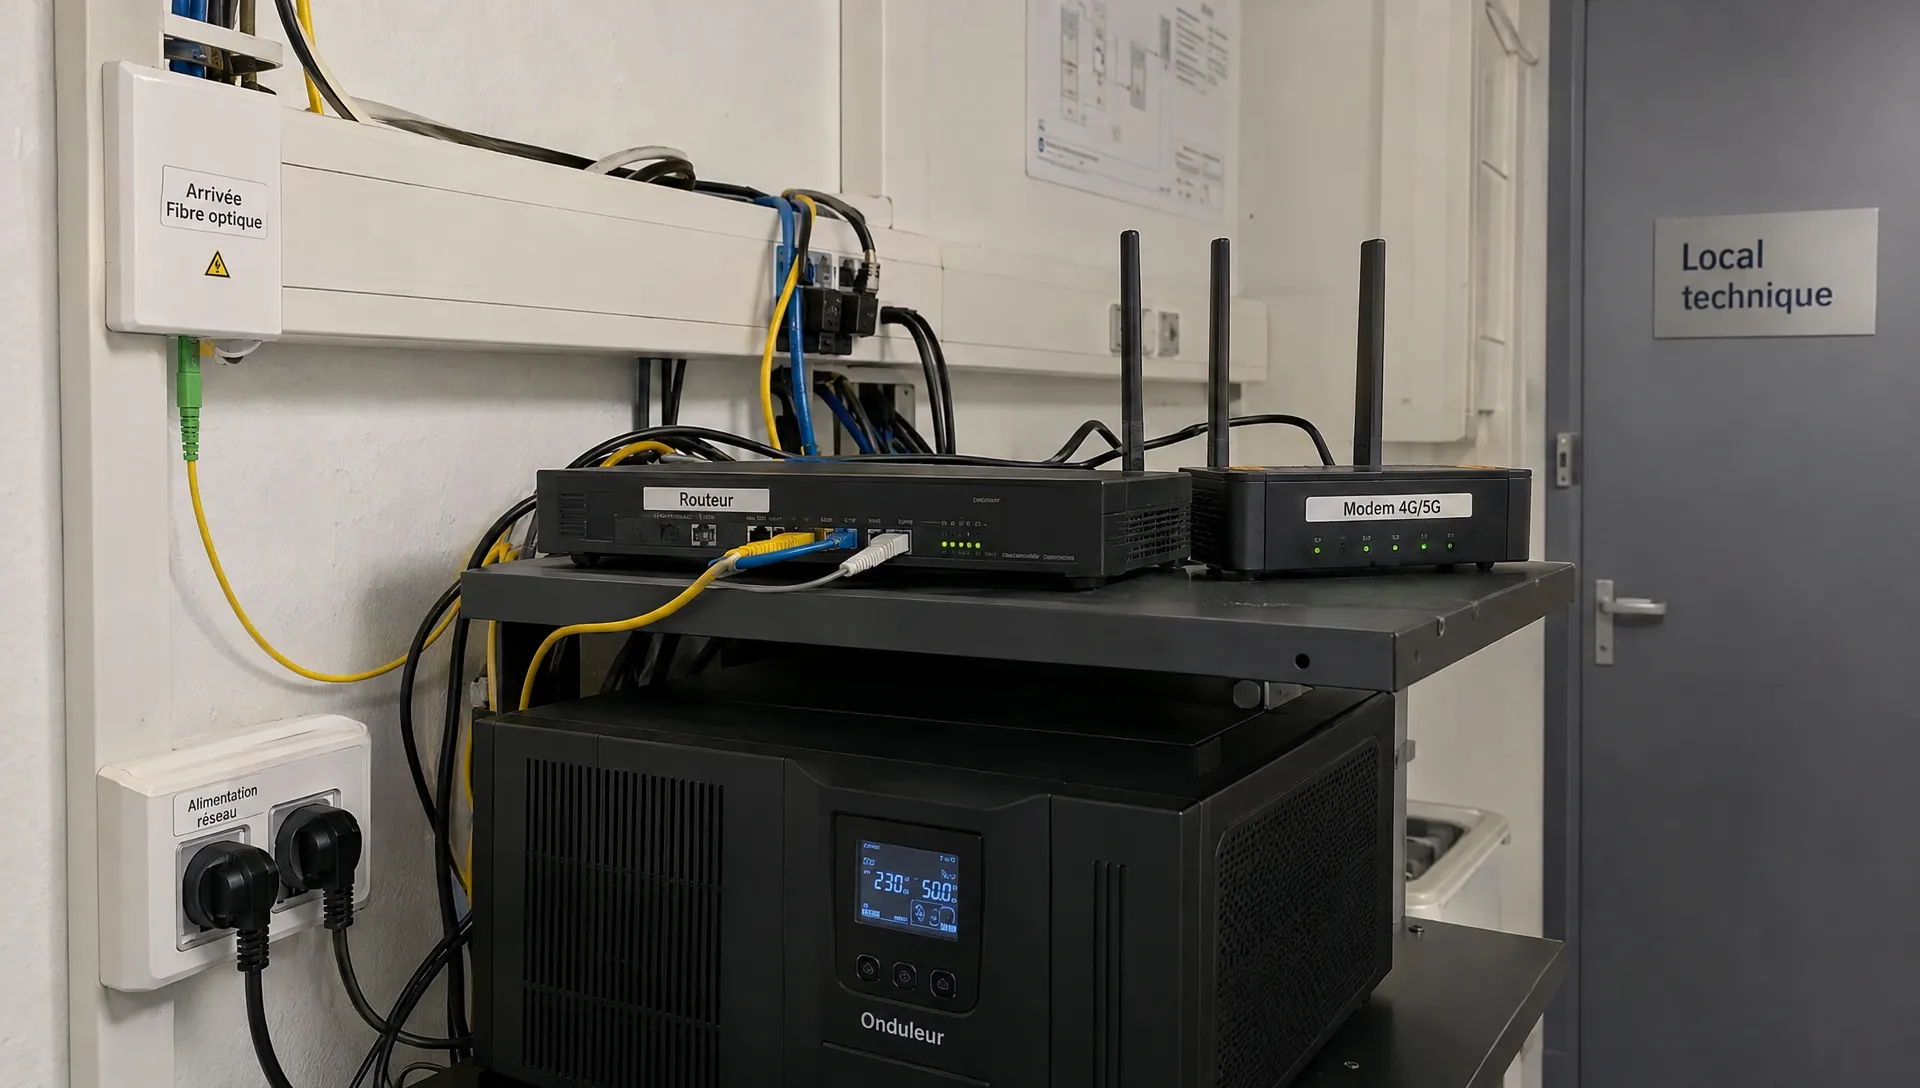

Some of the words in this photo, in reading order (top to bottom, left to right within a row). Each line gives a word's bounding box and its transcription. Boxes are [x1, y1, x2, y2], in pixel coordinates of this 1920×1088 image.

[186, 183, 242, 206] Arrivée
[166, 201, 204, 222] Fibre
[208, 211, 263, 231] optique
[1682, 239, 1764, 271] Local
[1682, 282, 1833, 314] technique
[679, 491, 734, 508] Routeur
[1343, 501, 1395, 517] Modem
[1399, 499, 1441, 517] 4G/5G
[187, 785, 258, 813] Alimentation
[197, 807, 237, 828] réseau
[874, 871, 904, 894] 230
[860, 1011, 945, 1046] Onduleur
